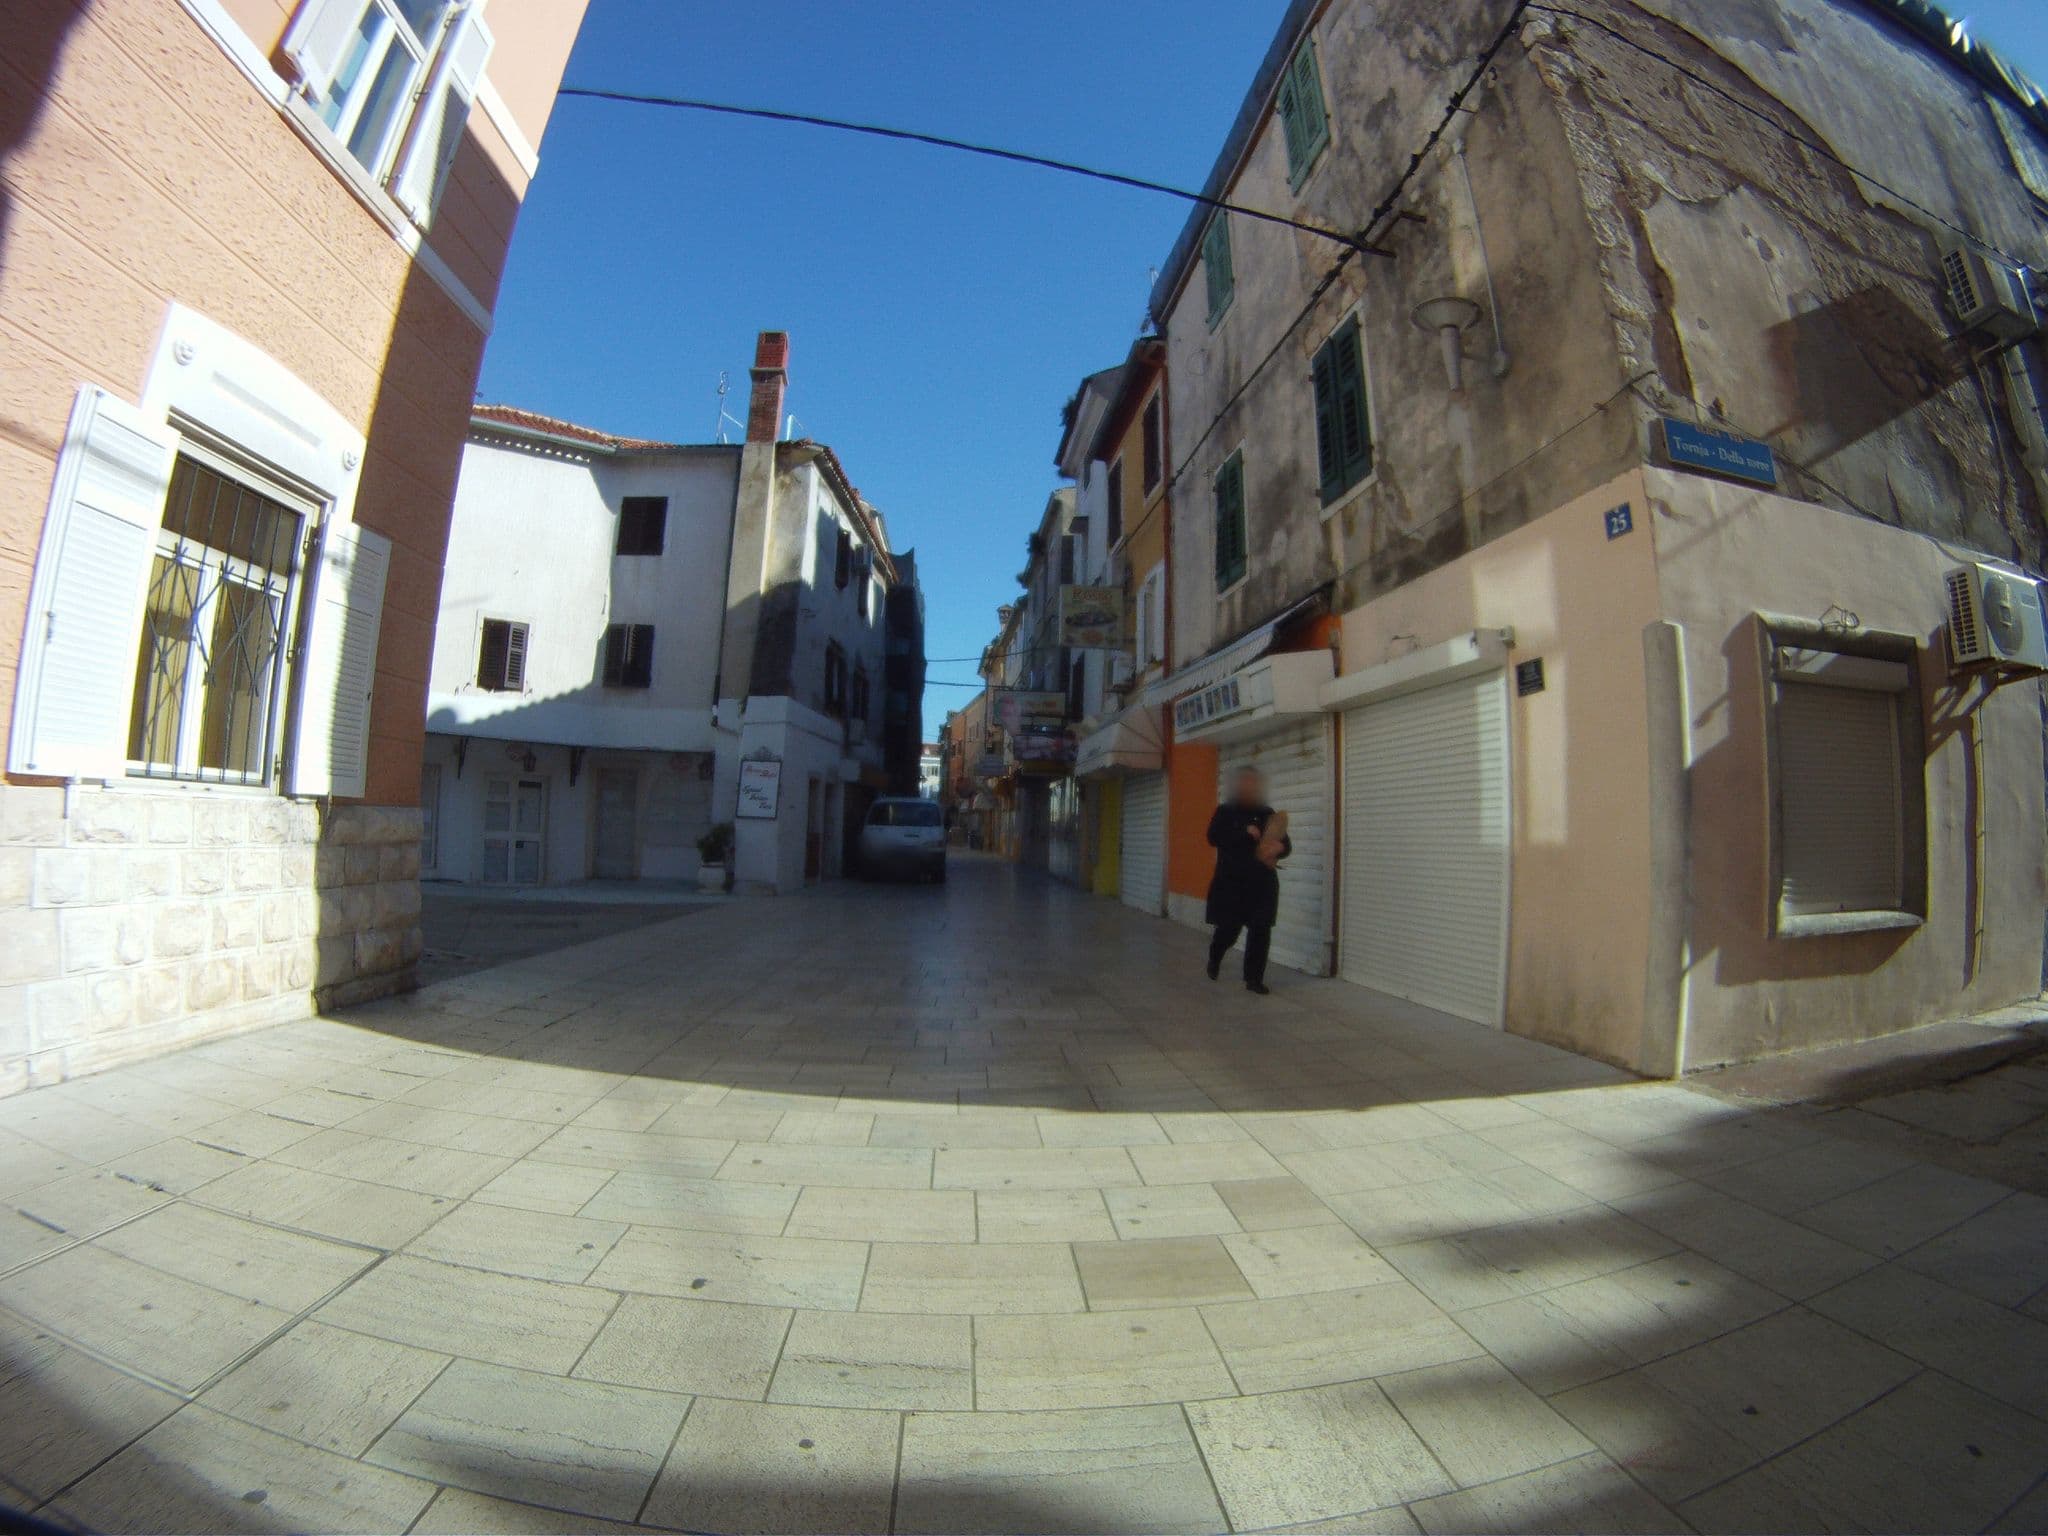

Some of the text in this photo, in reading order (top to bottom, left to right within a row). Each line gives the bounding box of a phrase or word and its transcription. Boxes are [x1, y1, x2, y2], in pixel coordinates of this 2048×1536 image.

[1673, 435, 1709, 457] Tornja
[1718, 447, 1744, 465] Della
[1611, 512, 1627, 534] 25
